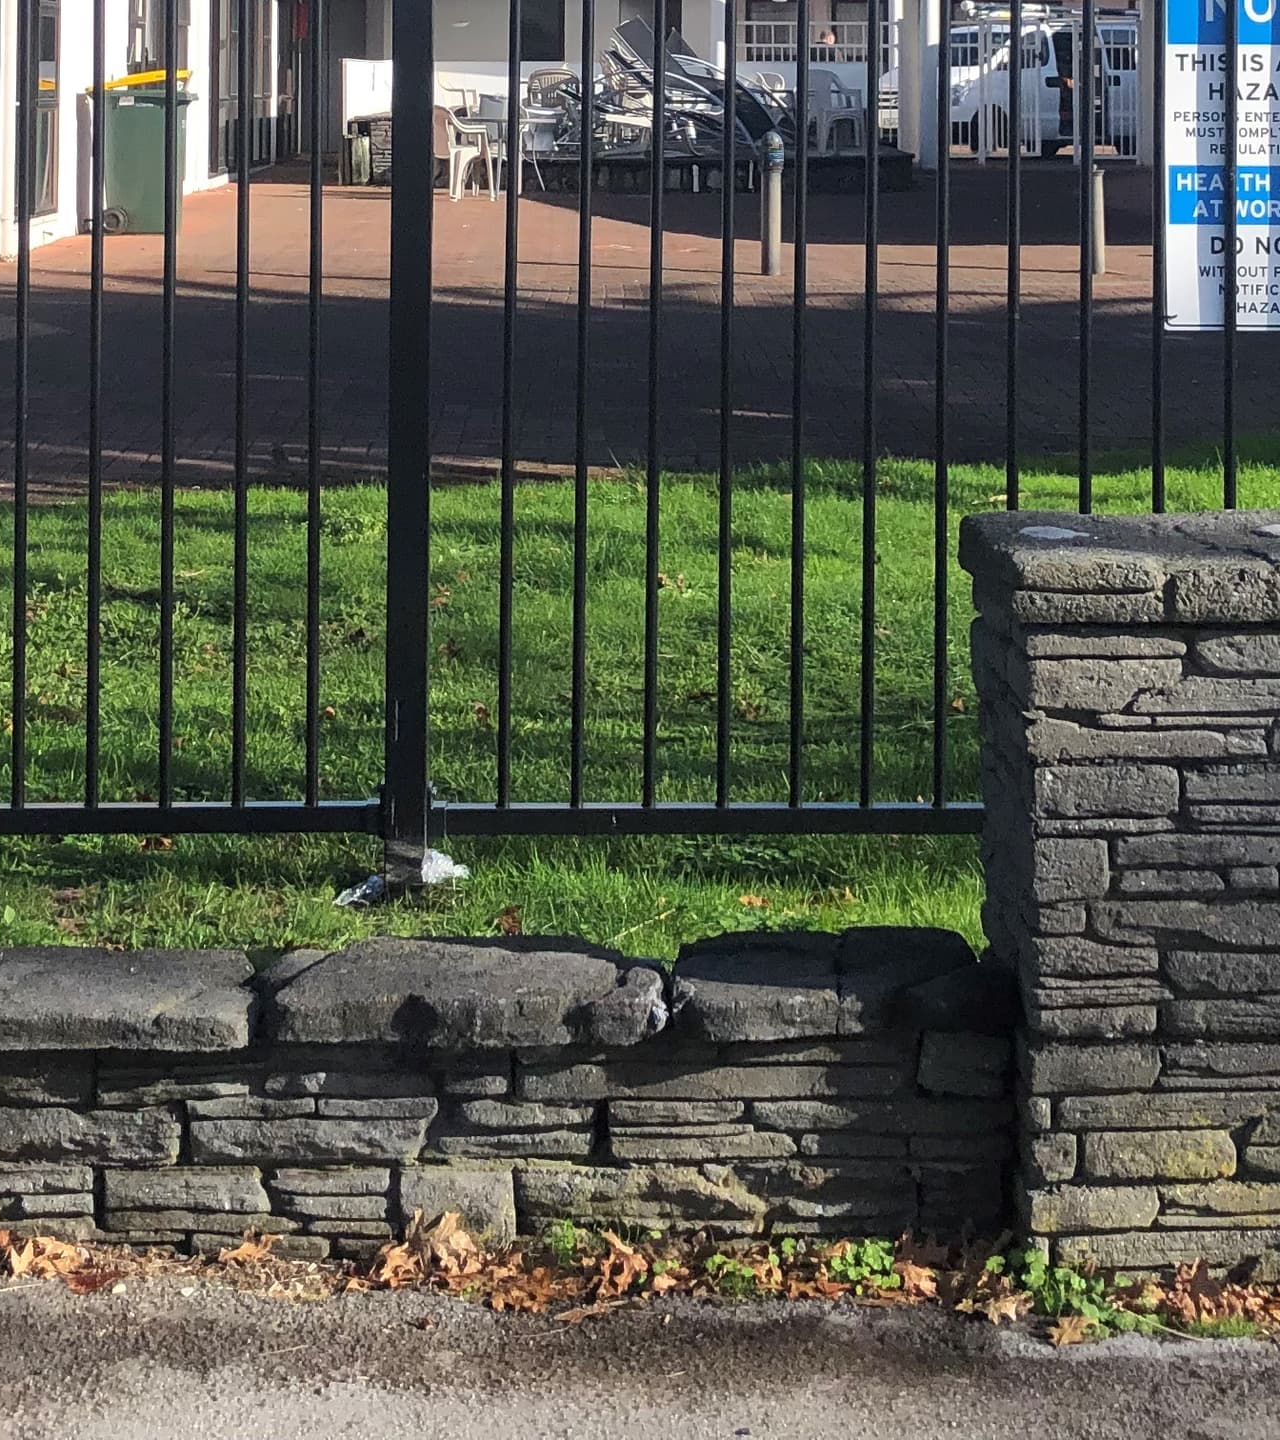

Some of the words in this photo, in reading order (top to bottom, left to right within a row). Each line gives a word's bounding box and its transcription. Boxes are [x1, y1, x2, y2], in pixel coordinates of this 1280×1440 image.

[1242, 54, 1264, 72] IS
[1185, 127, 1225, 138] MUST
[1176, 173, 1271, 192] HEATH
[1192, 200, 1223, 218] AT
[1199, 265, 1268, 278] WITOUT
